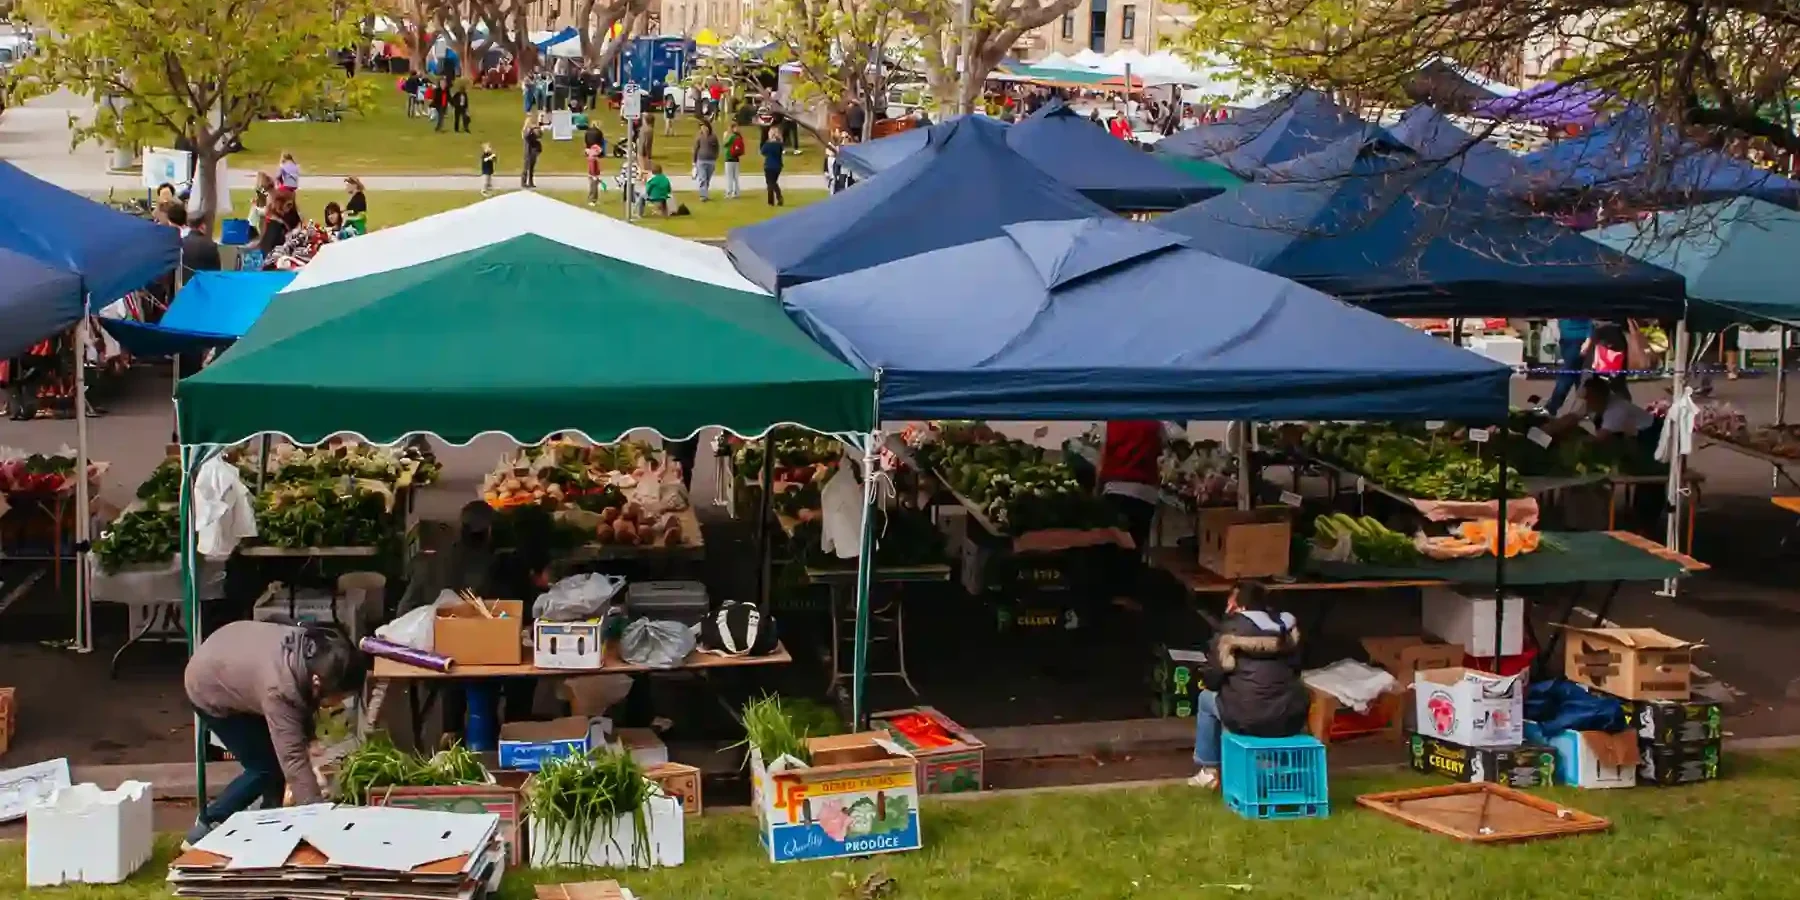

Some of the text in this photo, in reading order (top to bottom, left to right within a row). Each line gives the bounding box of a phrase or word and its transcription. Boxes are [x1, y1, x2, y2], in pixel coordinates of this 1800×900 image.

[1017, 616, 1057, 626] CELERY
[1429, 754, 1465, 774] CELERY
[783, 831, 900, 857] Quality PRODUCE
